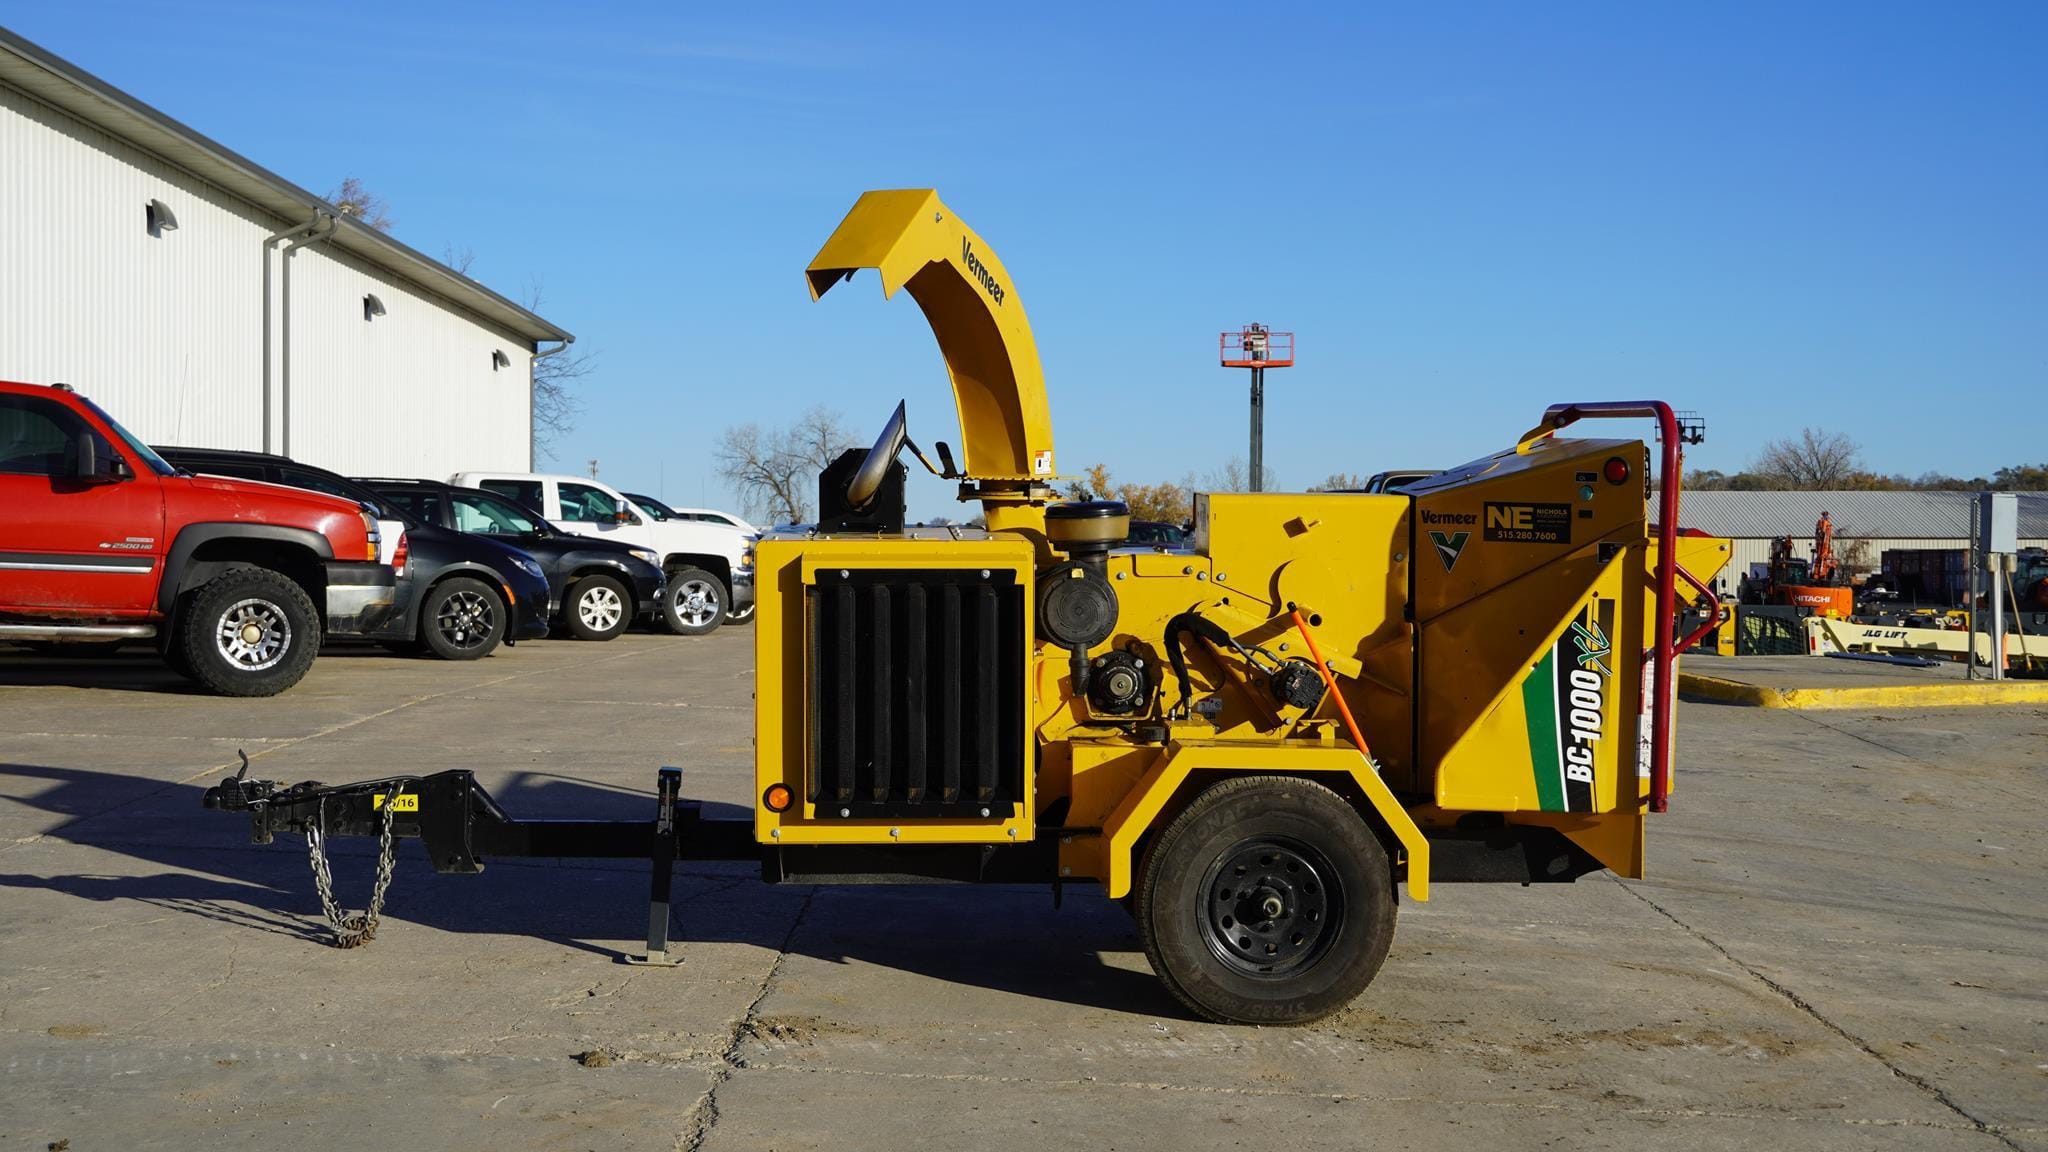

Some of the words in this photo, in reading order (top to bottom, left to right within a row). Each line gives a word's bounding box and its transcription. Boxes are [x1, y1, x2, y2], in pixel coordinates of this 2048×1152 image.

[962, 235, 1005, 307] Vermeer
[1421, 510, 1478, 525] Vermeer
[1487, 505, 1535, 529] NE
[1497, 530, 1557, 541] 515.280.7600
[1795, 594, 1831, 603] HITACHI
[1862, 629, 1882, 638] JLG
[1884, 630, 1908, 639] LIFT
[1571, 621, 1612, 676] XL
[1566, 669, 1602, 783] BC1000
